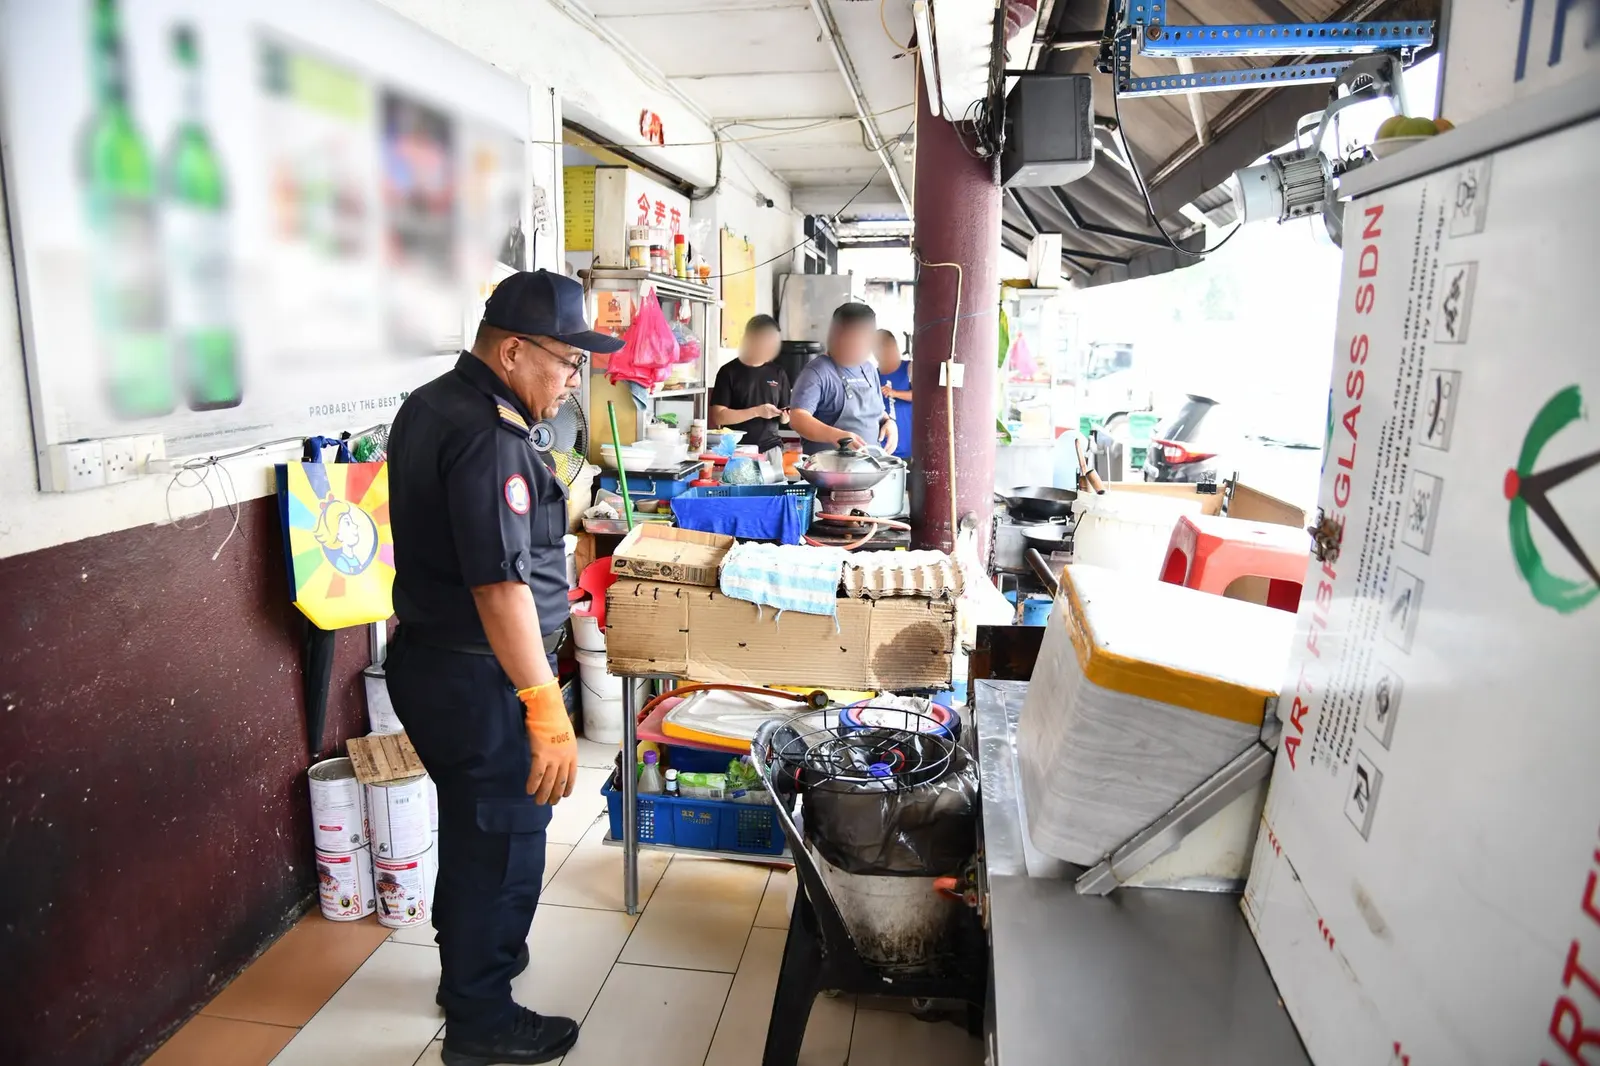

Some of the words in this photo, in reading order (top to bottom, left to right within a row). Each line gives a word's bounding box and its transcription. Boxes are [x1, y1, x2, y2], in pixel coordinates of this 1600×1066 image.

[309, 402, 357, 417] PROBABLY
[360, 400, 375, 411] THE
[378, 396, 397, 408] BEST
[1285, 663, 1312, 771] ART
[1356, 205, 1385, 313] SDN
[1324, 692, 1337, 742] Please
[1356, 505, 1374, 583] indicated
[1372, 420, 1388, 500] direction.
[1330, 699, 1344, 750] Please
[1363, 512, 1381, 597] protective
[1379, 476, 1387, 506] film
[1385, 416, 1396, 468] within
[1403, 297, 1413, 340] after
[1337, 706, 1351, 758] Please
[1372, 563, 1381, 599] care
[1378, 532, 1386, 557] for
[1383, 500, 1392, 528] the
[1390, 447, 1401, 494] panel
[1398, 385, 1411, 440] during
[1407, 246, 1429, 377] transportation
[1344, 737, 1353, 764] The
[1382, 554, 1391, 582] the
[1389, 501, 1401, 550] panel
[1399, 464, 1407, 494] will
[1405, 436, 1412, 457] be
[1409, 346, 1426, 429] damaged
[1422, 318, 1430, 339] by
[1426, 258, 1439, 310] sharp
[1538, 937, 1600, 1066] RT
